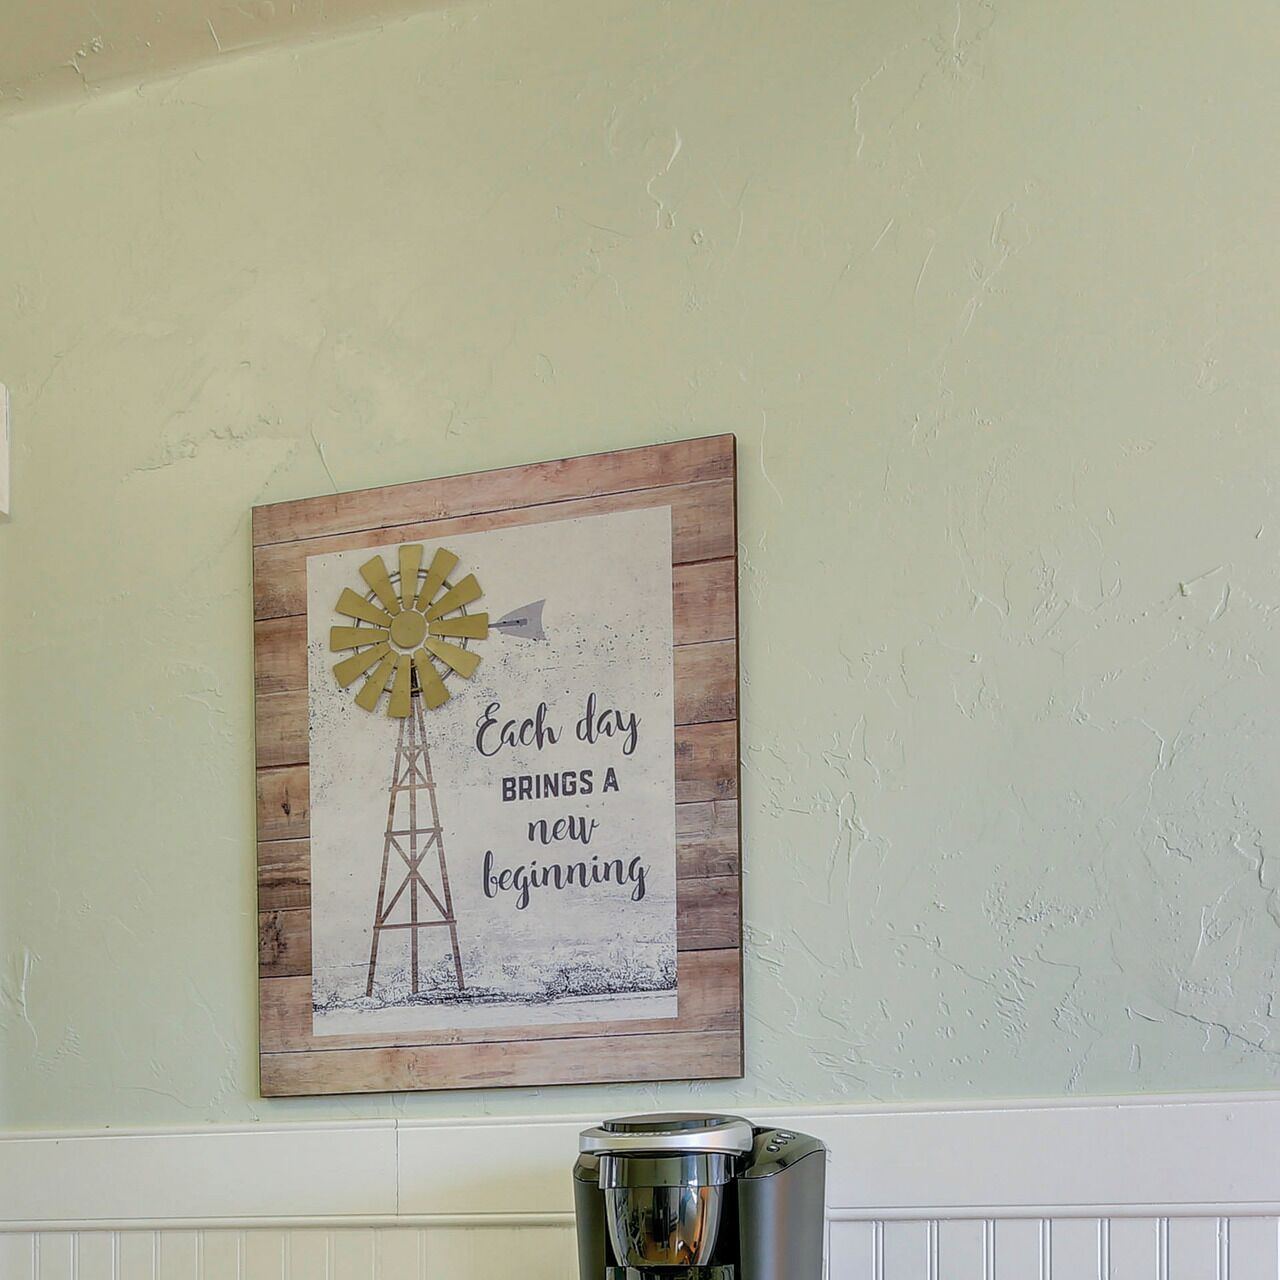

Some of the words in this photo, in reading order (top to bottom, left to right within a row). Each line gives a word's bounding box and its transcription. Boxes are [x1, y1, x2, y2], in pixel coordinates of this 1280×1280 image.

[476, 702, 562, 757] Each
[576, 692, 641, 755] day
[502, 770, 593, 801] BRINGS
[602, 767, 619, 793] A
[528, 815, 599, 844] new
[483, 850, 650, 910] beginning
